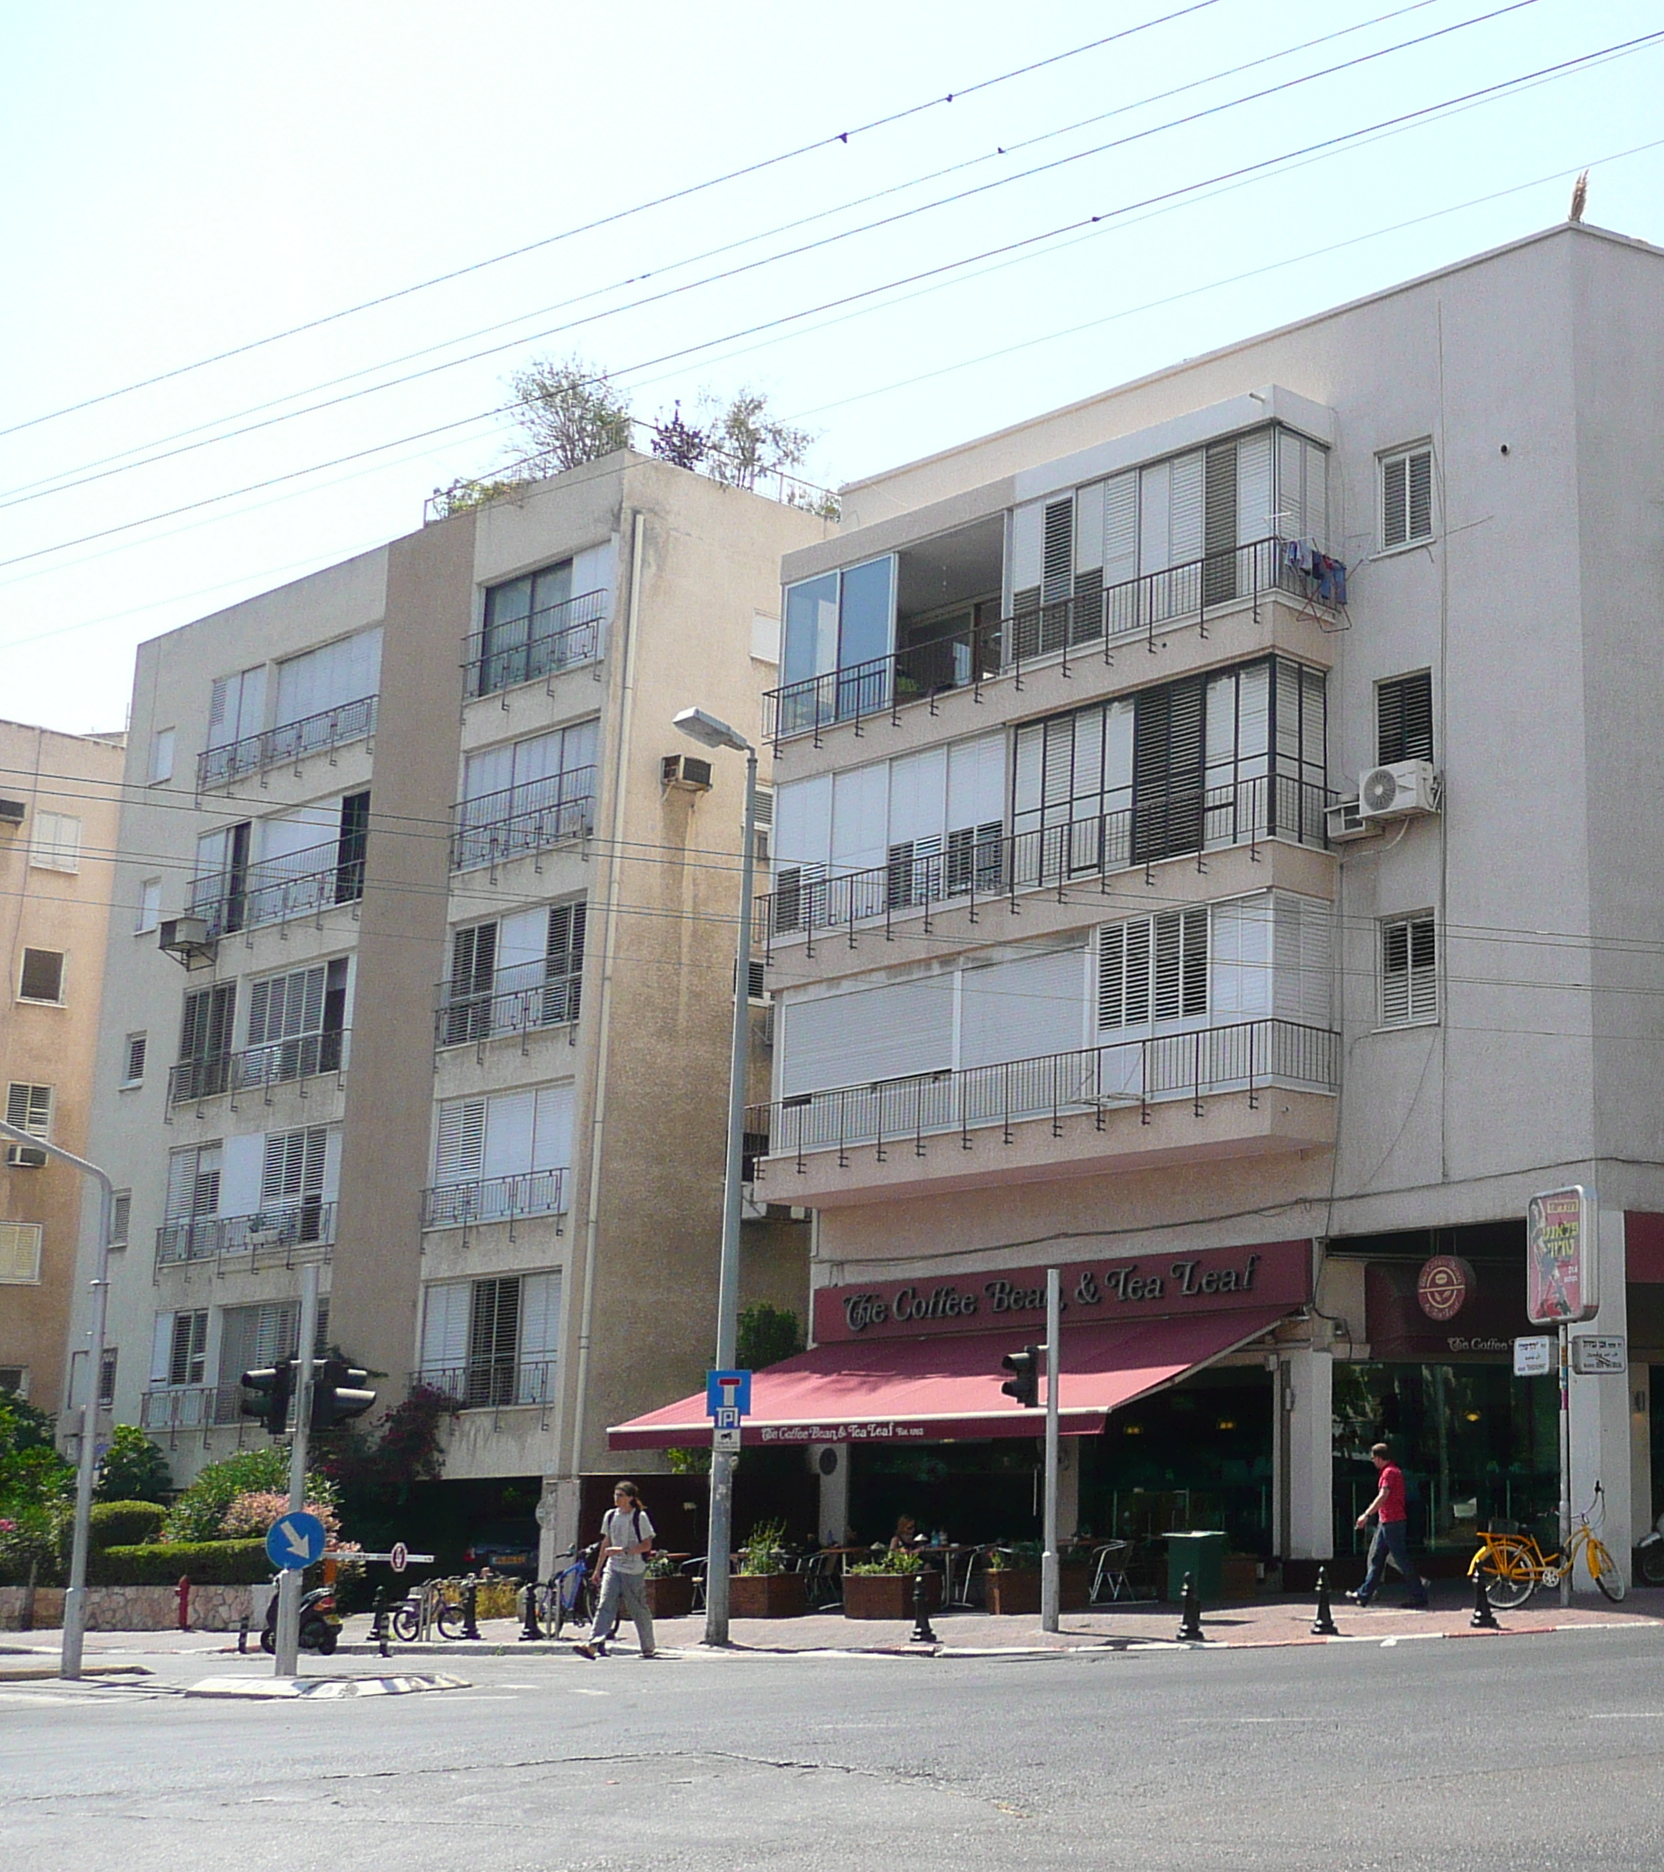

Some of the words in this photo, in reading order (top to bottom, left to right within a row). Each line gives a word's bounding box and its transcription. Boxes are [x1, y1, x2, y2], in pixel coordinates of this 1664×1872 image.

[843, 1291, 888, 1331] The
[893, 1285, 978, 1322] Coffee
[1074, 1271, 1102, 1304] &
[1104, 1264, 1164, 1301] Tea
[1170, 1253, 1261, 1297] Leaf
[778, 1426, 809, 1440] Coffee
[848, 1424, 867, 1438] Tea
[868, 1422, 895, 1437] Leaf
